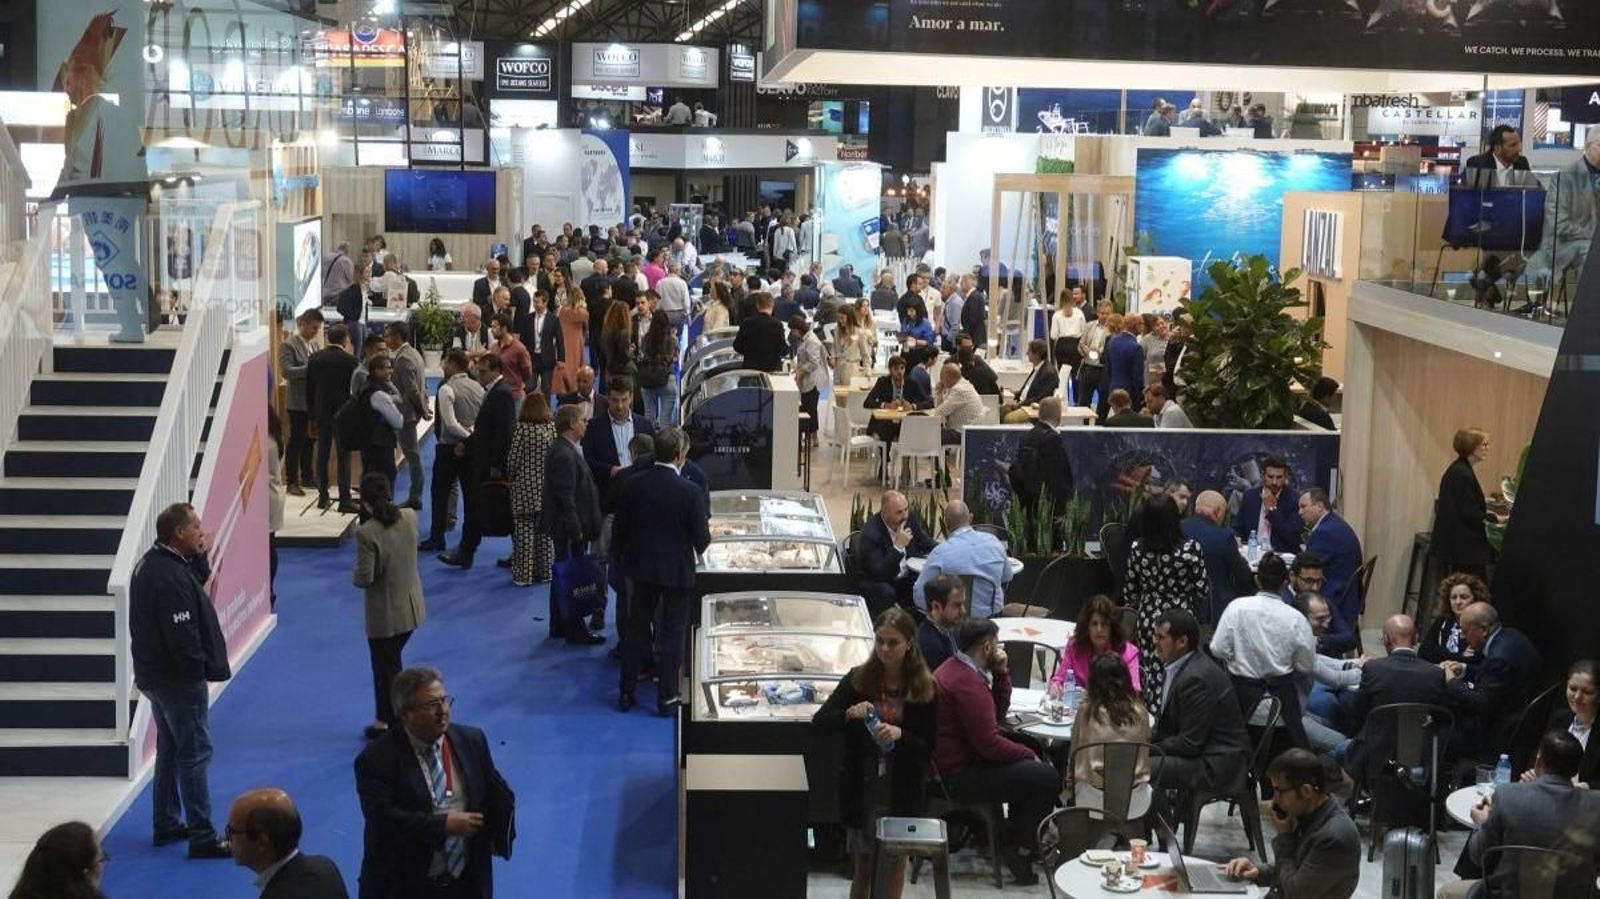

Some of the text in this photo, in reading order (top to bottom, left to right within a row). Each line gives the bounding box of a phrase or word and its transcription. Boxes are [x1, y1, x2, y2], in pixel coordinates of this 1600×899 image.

[908, 15, 1005, 32] Amor a mar.
[1464, 45, 1478, 55] WE
[1479, 46, 1509, 55] CATCH.
[1511, 47, 1525, 55] WE
[1526, 48, 1566, 57] PROCESS.
[1567, 48, 1581, 57] WE
[500, 61, 547, 74] WOFCO
[1382, 110, 1478, 119] CASTELLAR
[172, 610, 191, 624] HH
